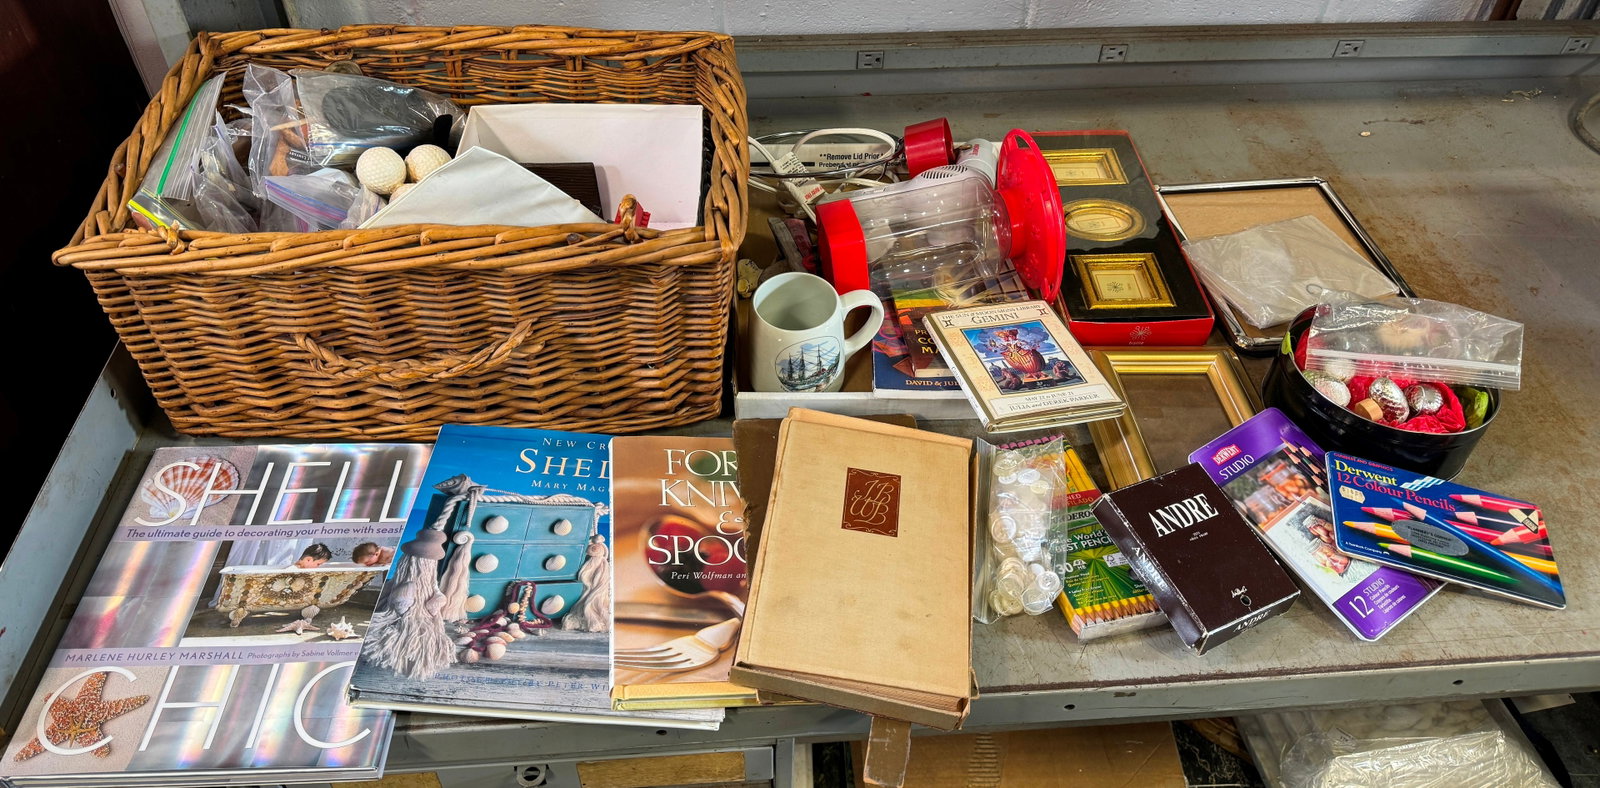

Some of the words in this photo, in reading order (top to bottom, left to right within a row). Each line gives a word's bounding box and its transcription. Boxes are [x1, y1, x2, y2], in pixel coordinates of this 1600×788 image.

[853, 152, 863, 160] Lid
[864, 152, 880, 160] Prior
[971, 312, 1020, 325] GEMINI
[1009, 404, 1031, 412] JULIA
[1043, 399, 1070, 407] DEREK
[1070, 394, 1101, 402] PARKER
[542, 437, 577, 448] NEW
[586, 441, 606, 450] CR
[1213, 446, 1240, 464] DERWENT
[1219, 454, 1255, 480] STUDIO
[1334, 459, 1398, 486] Derwent
[134, 460, 408, 526] SHELL
[531, 480, 568, 490] MARY
[576, 483, 609, 492] MAG
[1337, 472, 1352, 483] 12
[1353, 476, 1404, 498] Colour
[1405, 489, 1456, 512] Pencils
[716, 510, 743, 535] &
[1148, 493, 1219, 537] ANDRE
[126, 528, 146, 538] The
[147, 528, 191, 538] ultimate
[192, 528, 223, 539] guide
[225, 529, 235, 537] to
[237, 528, 296, 538] decorating
[296, 528, 320, 539] your
[320, 525, 350, 535] home
[352, 525, 374, 534] with
[1073, 530, 1105, 540] World'
[671, 571, 690, 580] Peri
[693, 571, 733, 581] Wolfman
[1055, 562, 1073, 574] 30
[1131, 547, 1168, 591] ANDRE
[1362, 578, 1385, 596] STUDIO
[1349, 595, 1375, 618] 12
[1232, 610, 1271, 632] ANDRE
[65, 652, 124, 662] MARLENE
[127, 652, 176, 661] HURLEY
[179, 651, 244, 660] MARSHALL
[247, 650, 290, 659] Photographs
[292, 650, 300, 658] by
[301, 649, 325, 657] Sabine
[591, 683, 609, 691] WI
[36, 661, 371, 756] CHIC
